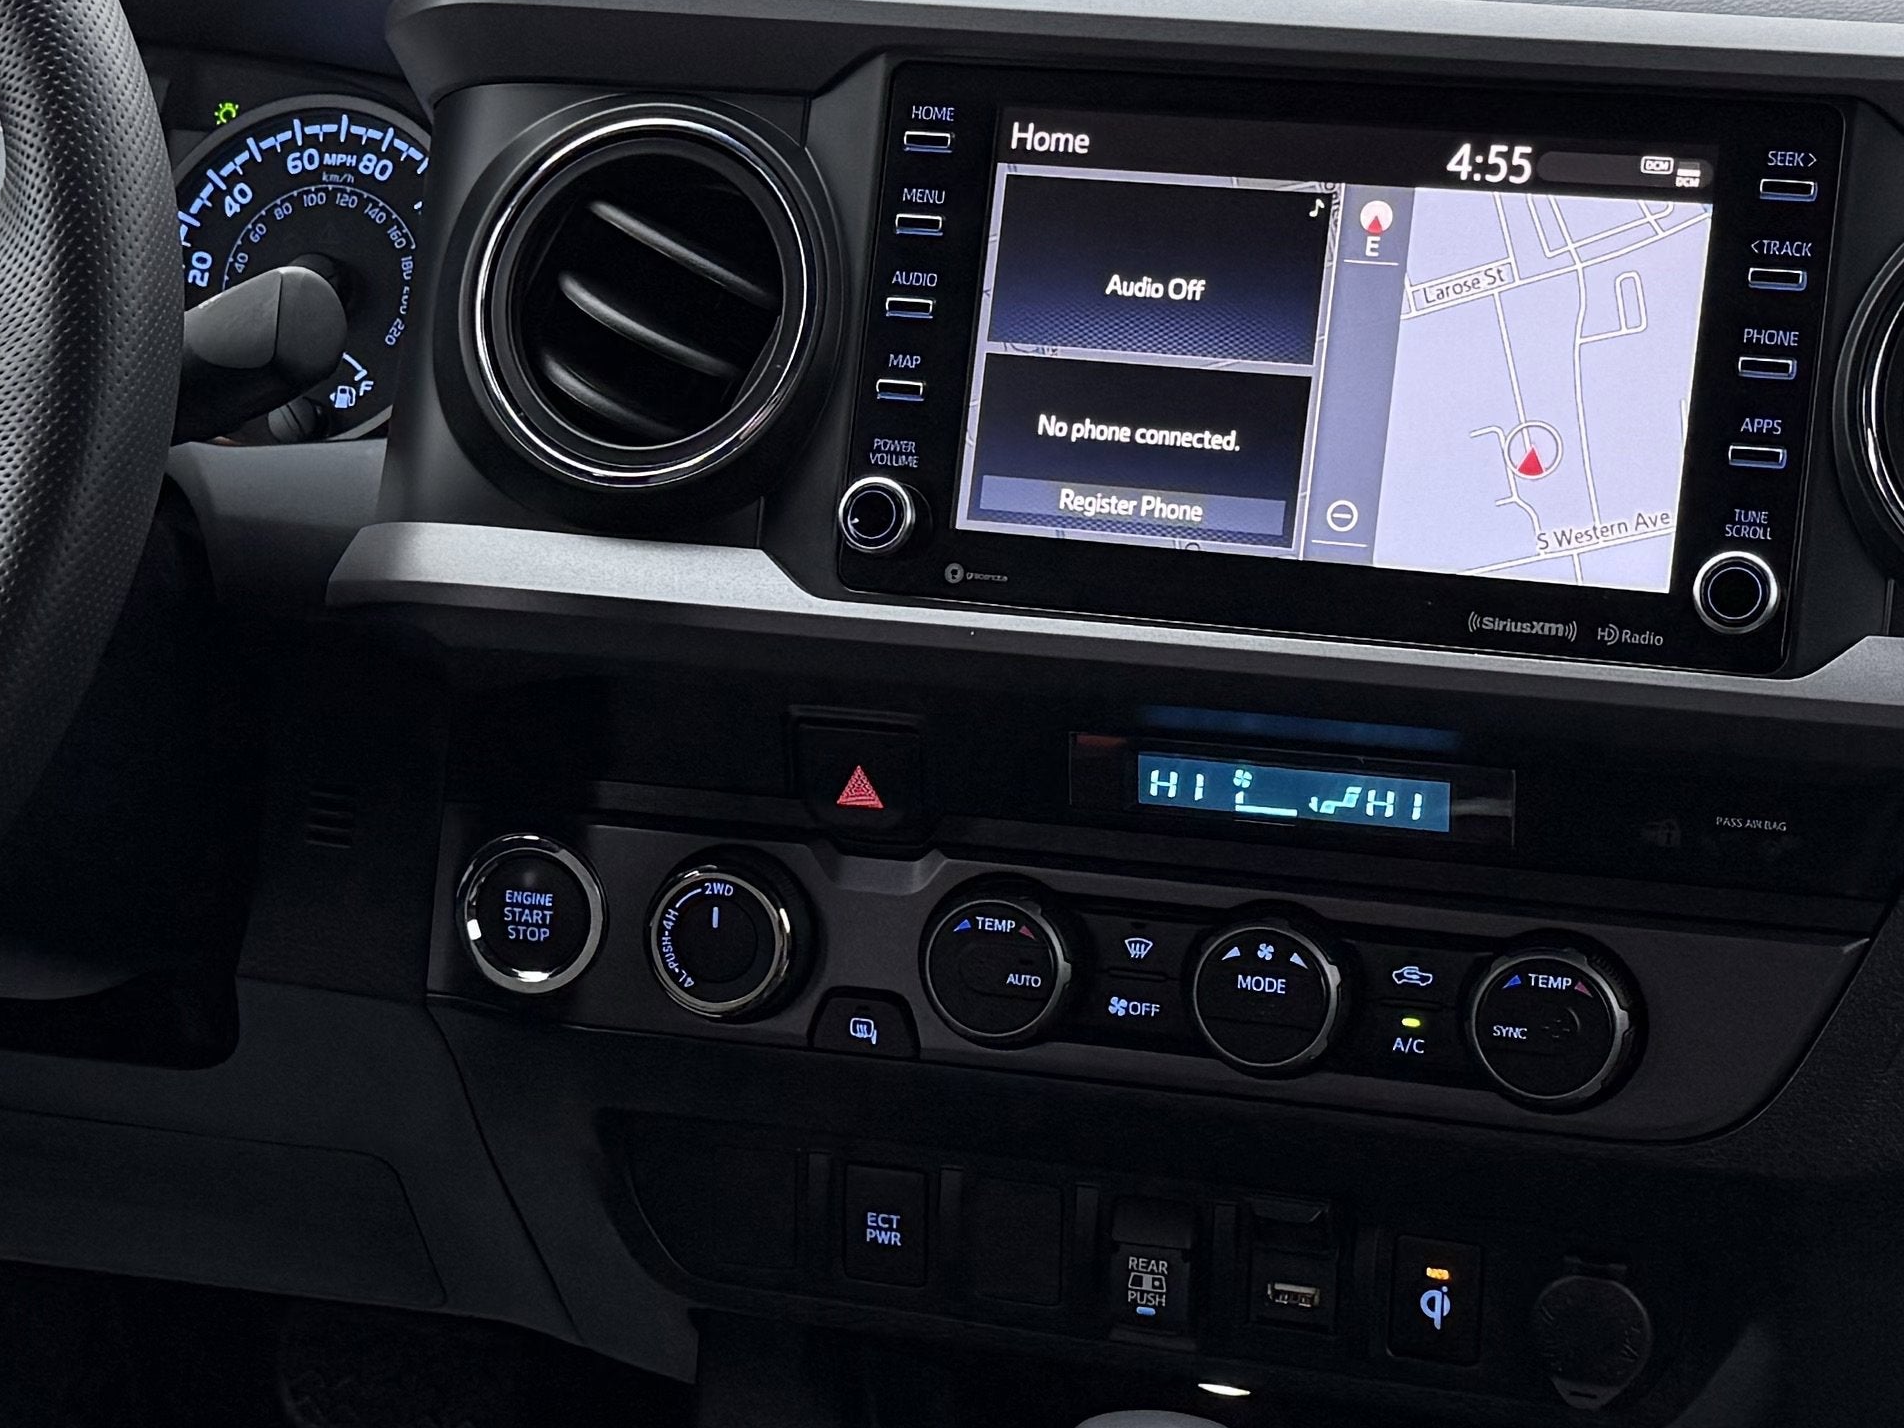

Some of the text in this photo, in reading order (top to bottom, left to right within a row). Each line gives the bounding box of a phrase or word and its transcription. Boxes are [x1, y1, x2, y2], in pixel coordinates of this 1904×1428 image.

[911, 105, 955, 122] HOME
[1010, 121, 1090, 154] Home
[286, 148, 320, 175] 60
[323, 153, 357, 167] MPH
[358, 153, 393, 181] 80
[1446, 143, 1533, 184] 4:55
[322, 172, 355, 184] km/h
[224, 182, 253, 217] 40
[303, 192, 327, 207] 100
[335, 193, 358, 209] 120
[902, 188, 946, 204] MENU
[273, 202, 293, 220] 80
[364, 203, 387, 224] 140
[386, 225, 407, 249] 160
[1365, 236, 1381, 257] E
[1763, 240, 1812, 257] TRACK
[187, 251, 213, 287] 20
[234, 252, 249, 273] 40
[891, 270, 938, 287] AUDIO
[1423, 267, 1505, 304] Larose St
[1105, 274, 1206, 301] Audio Off
[1743, 328, 1799, 346] PHONE
[888, 353, 921, 368] MAP
[358, 380, 374, 396] F
[1038, 414, 1241, 452] No phone connected.
[1740, 418, 1782, 434] APPS
[873, 438, 916, 453] POWER
[870, 452, 919, 468] VOLUME
[1059, 488, 1203, 521] Register Phone
[1734, 509, 1769, 523] TUNE
[1537, 511, 1671, 550] S Western Ave
[1725, 524, 1772, 540] SCROLL
[1622, 630, 1664, 646] Radio
[1716, 816, 1742, 828] PASS
[704, 882, 734, 897] 2WD
[505, 890, 553, 907] ENGINE
[504, 907, 554, 924] START
[508, 925, 550, 941] STOP
[976, 917, 1016, 933] TEMP
[1006, 973, 1042, 988] AUTO
[1237, 974, 1287, 994] MODE
[1528, 973, 1572, 991] TEMP
[1129, 1001, 1161, 1017] OFF
[1493, 1025, 1528, 1040] SYNC
[1392, 1037, 1425, 1054] A/C
[866, 1211, 901, 1229] ECT
[866, 1228, 902, 1246] PWR
[1128, 1256, 1168, 1274] REAR
[1127, 1290, 1166, 1307] PUSH
